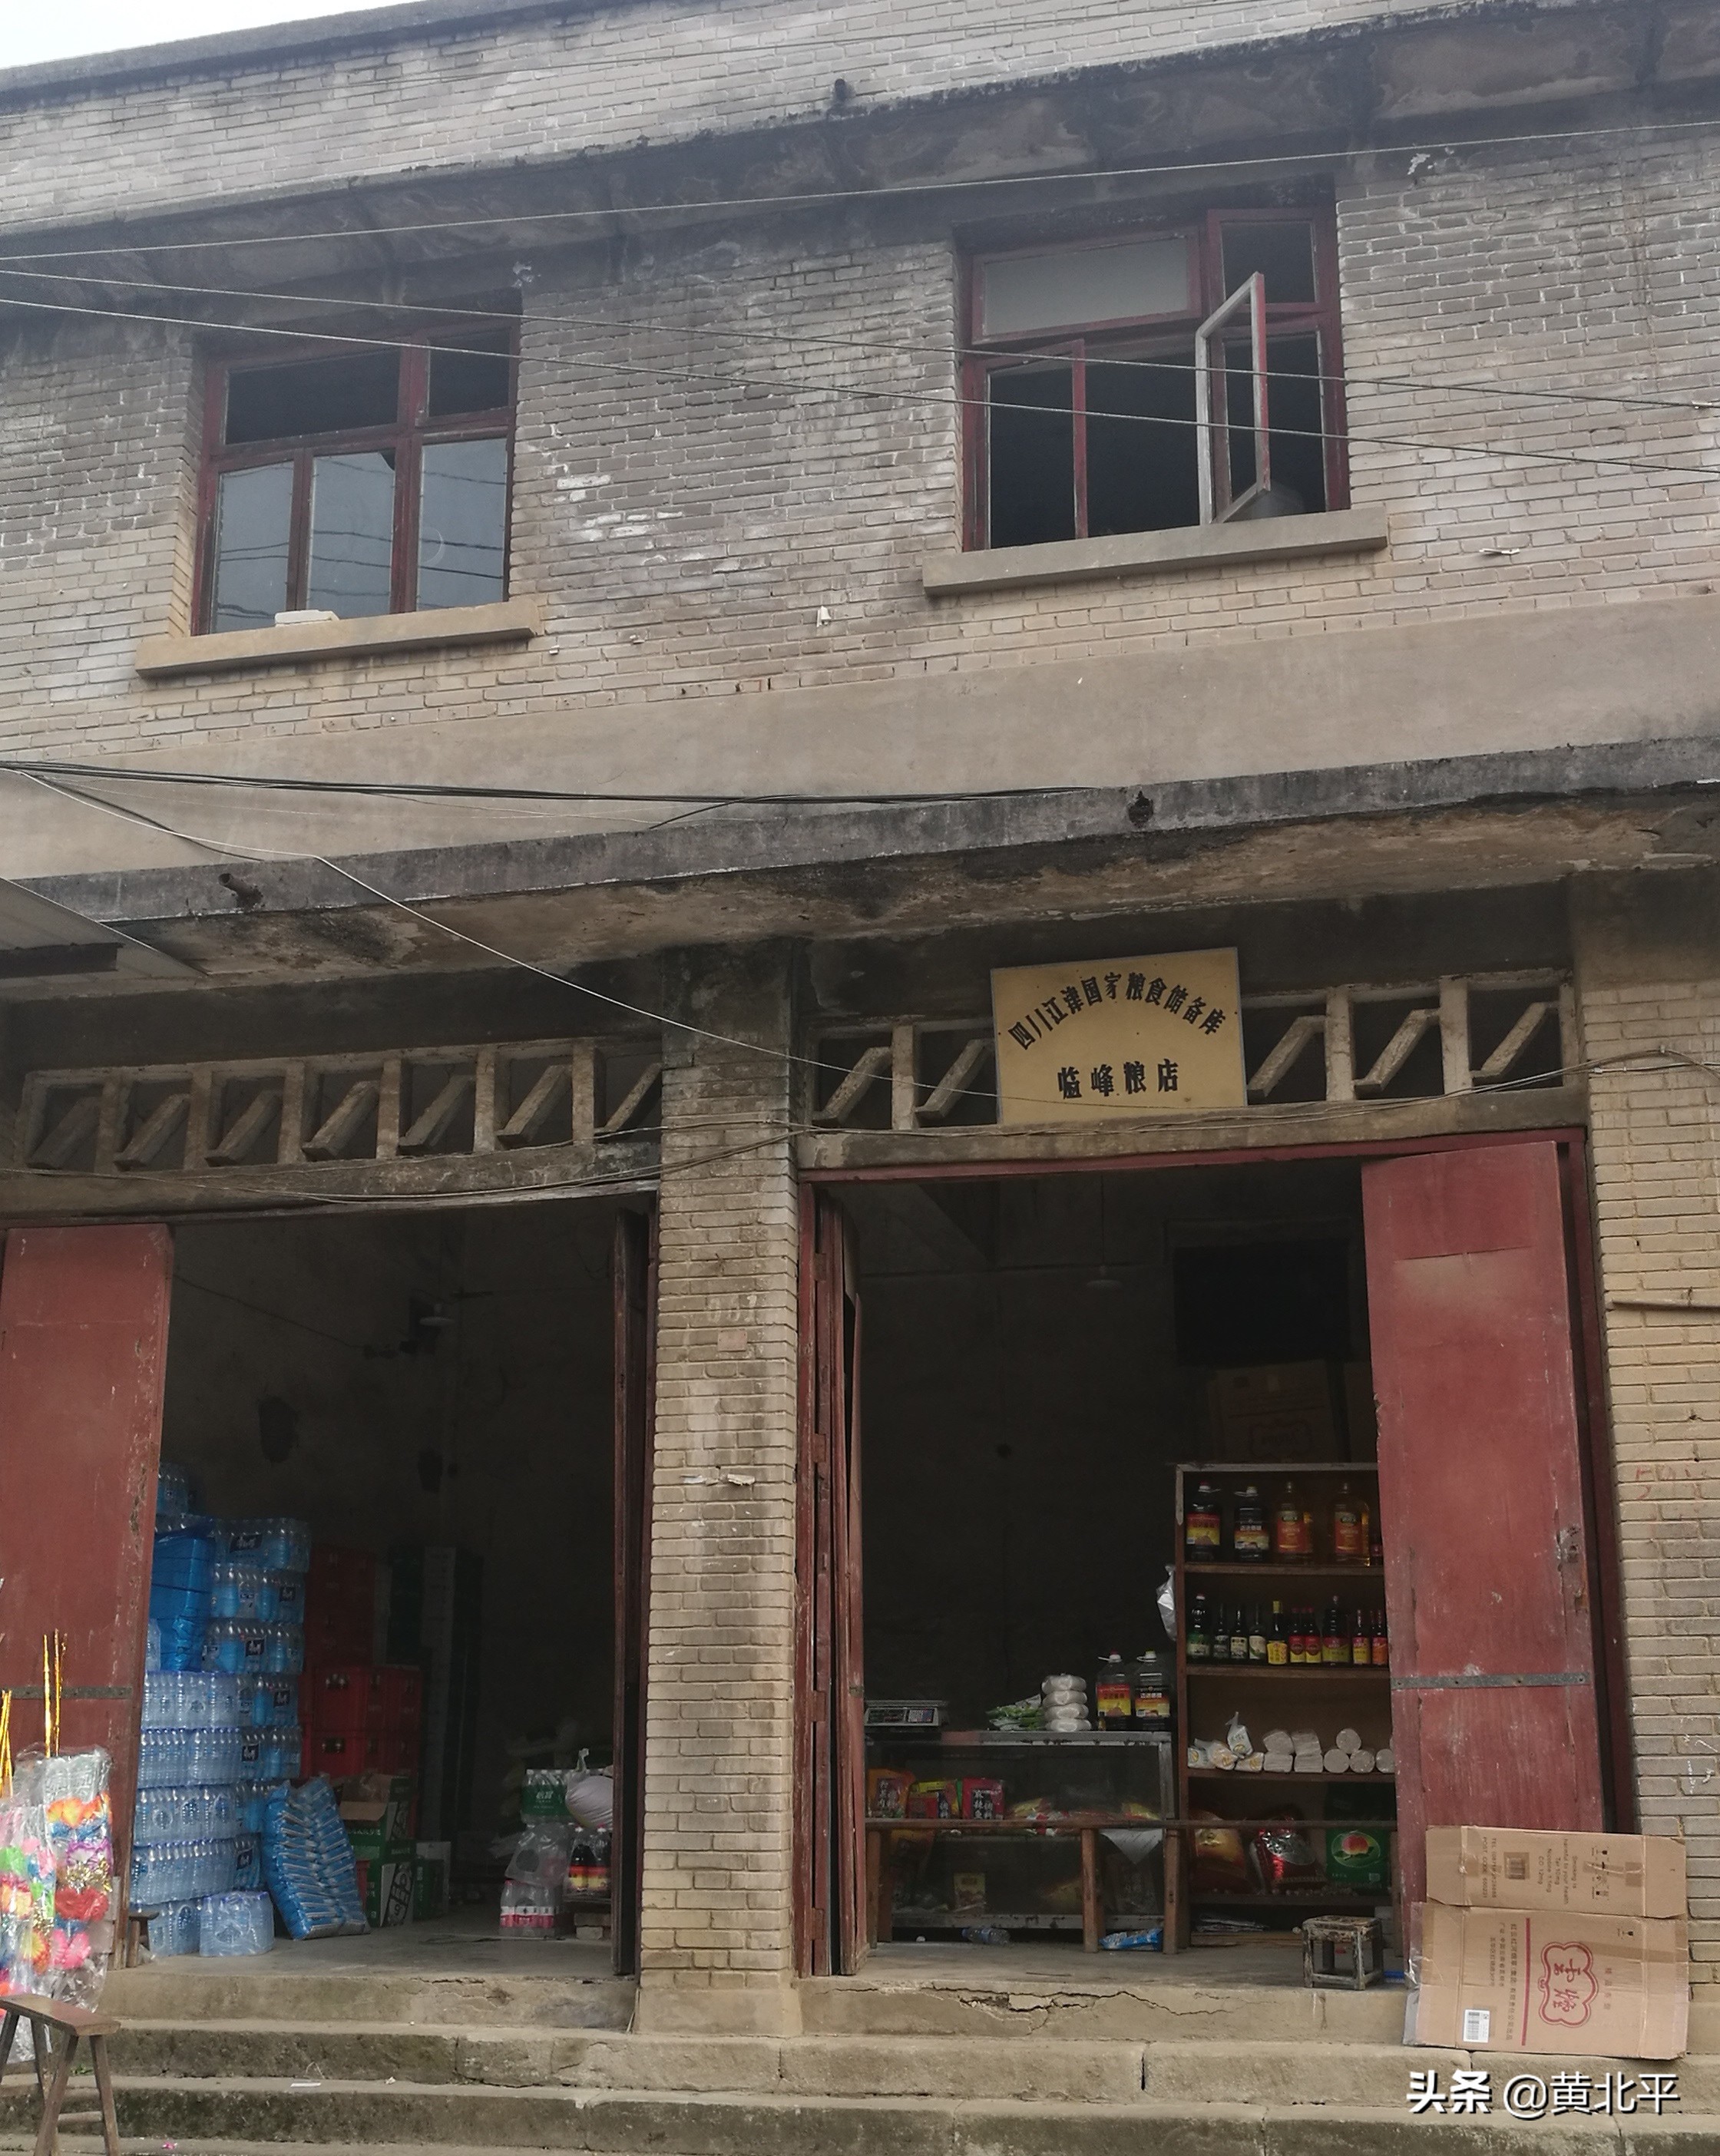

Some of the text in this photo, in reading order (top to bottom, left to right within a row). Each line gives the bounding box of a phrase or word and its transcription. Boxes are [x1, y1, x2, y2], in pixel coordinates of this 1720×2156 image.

[1007, 971, 1226, 1050] 四川江津国家粮食储备库
[1057, 1058, 1179, 1099] 临峰粮店
